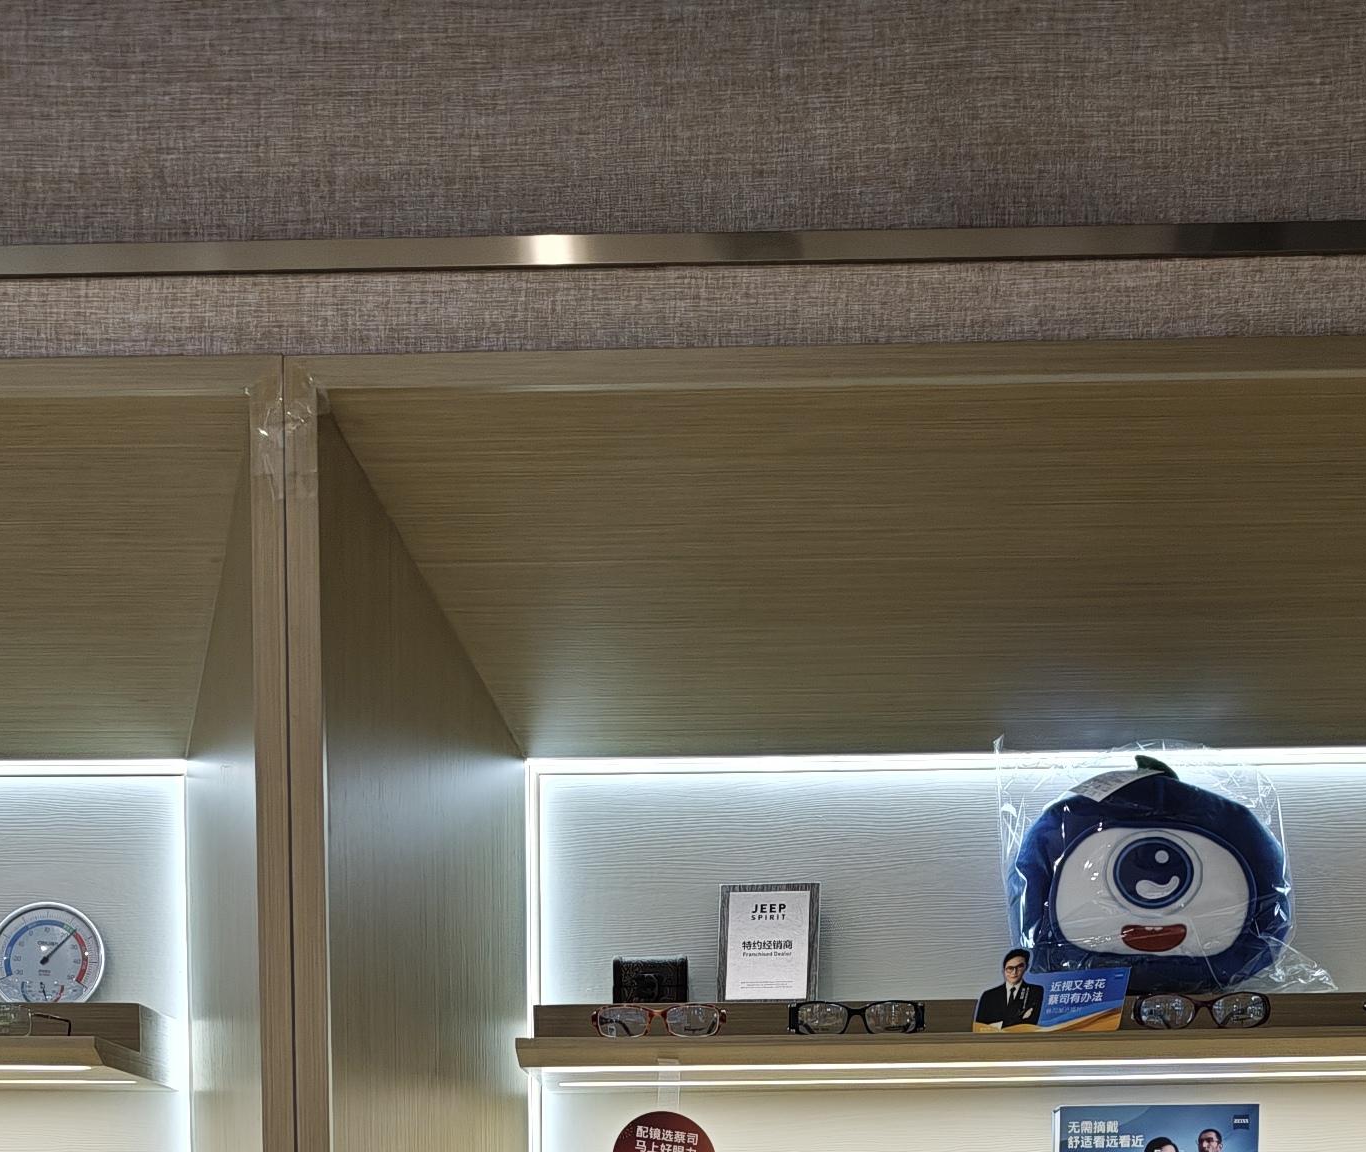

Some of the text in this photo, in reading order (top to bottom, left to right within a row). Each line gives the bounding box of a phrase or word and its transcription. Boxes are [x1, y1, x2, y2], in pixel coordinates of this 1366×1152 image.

[752, 903, 786, 913] JEEP
[742, 940, 793, 950] 特约经销商
[1050, 978, 1106, 992] 近视又老花
[1048, 991, 1104, 1005] 蔡司有办法
[1067, 1120, 1119, 1134] 无需摘戴
[635, 1125, 699, 1146] 配镜选蔡司
[1067, 1135, 1145, 1149] 舒适看远看近
